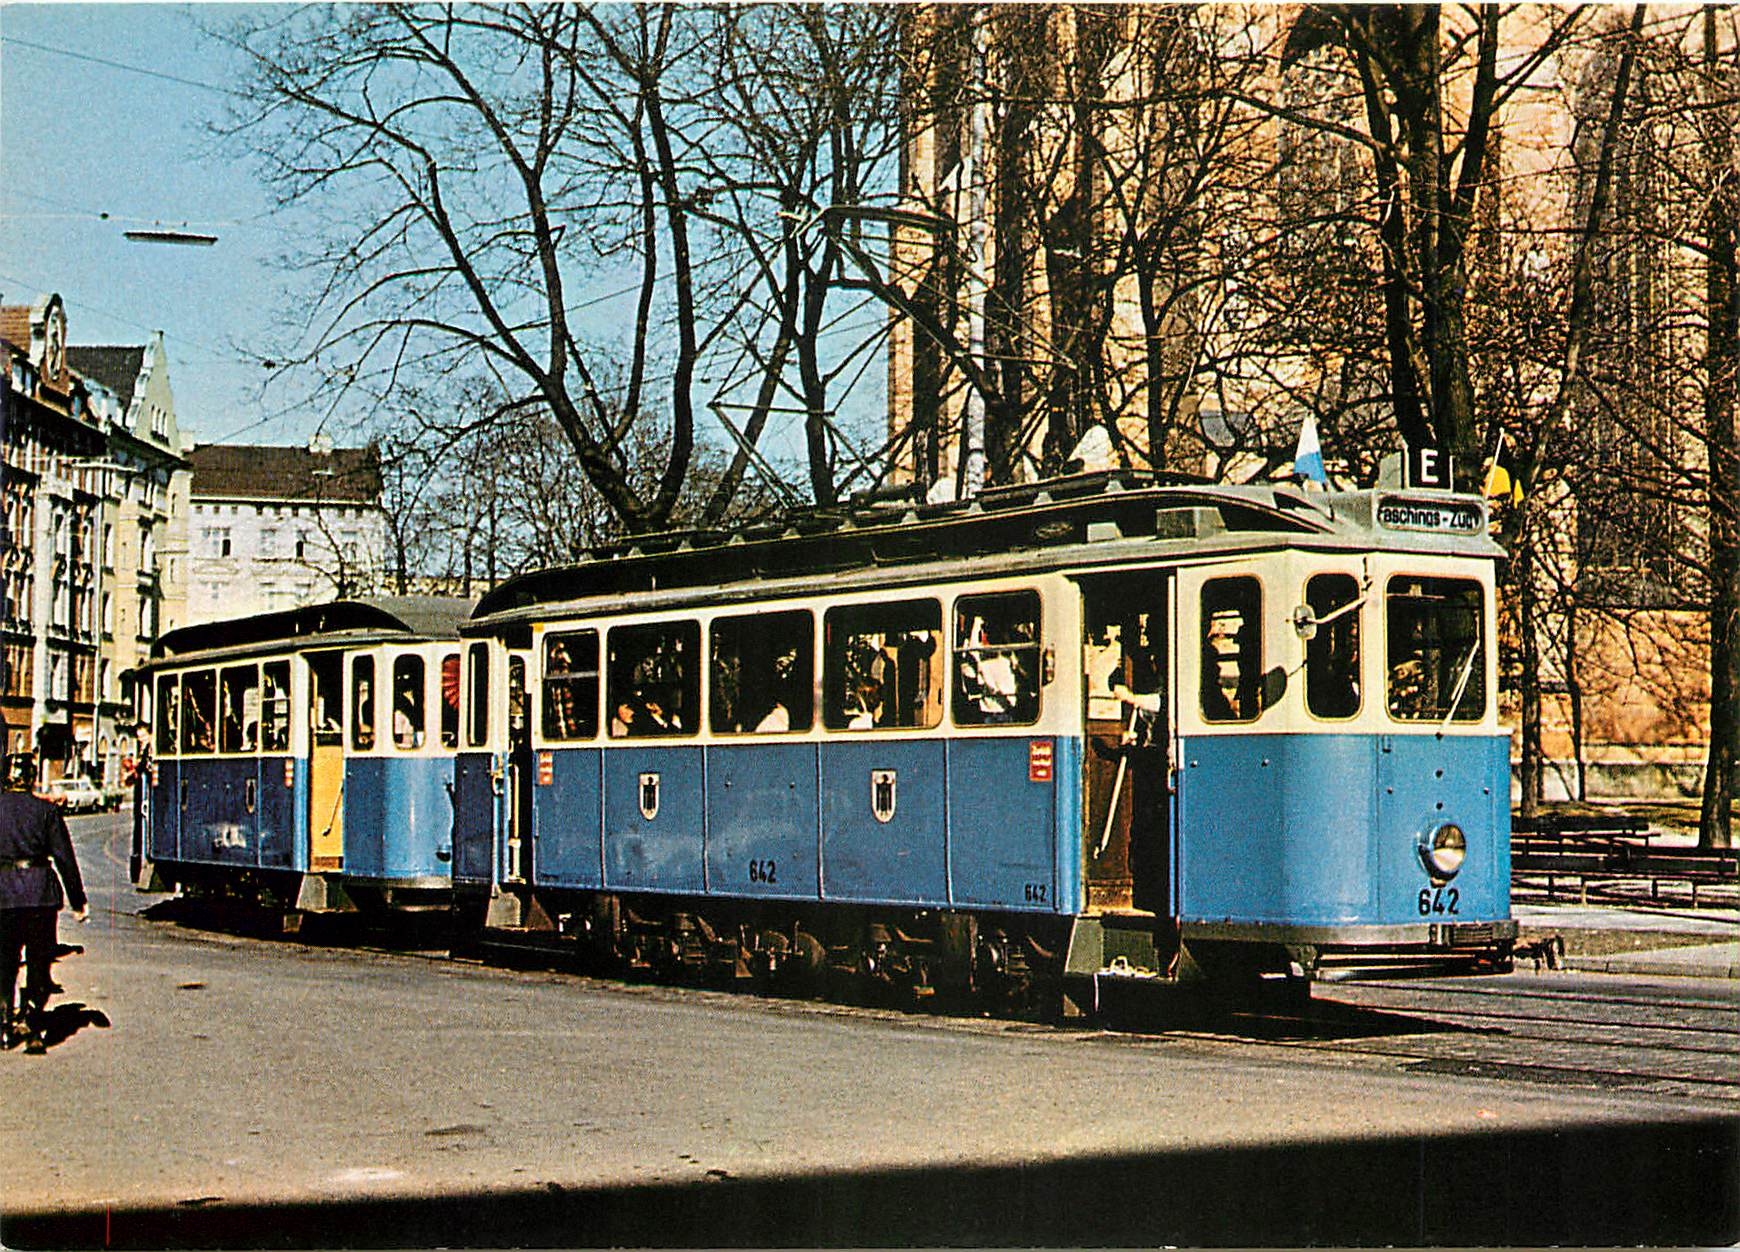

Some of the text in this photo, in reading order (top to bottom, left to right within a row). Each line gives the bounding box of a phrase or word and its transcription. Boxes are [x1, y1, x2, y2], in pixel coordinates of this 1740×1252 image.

[1420, 448, 1439, 483] E
[749, 859, 777, 884] 642
[1025, 884, 1047, 902] 642
[1418, 887, 1459, 916] 642
